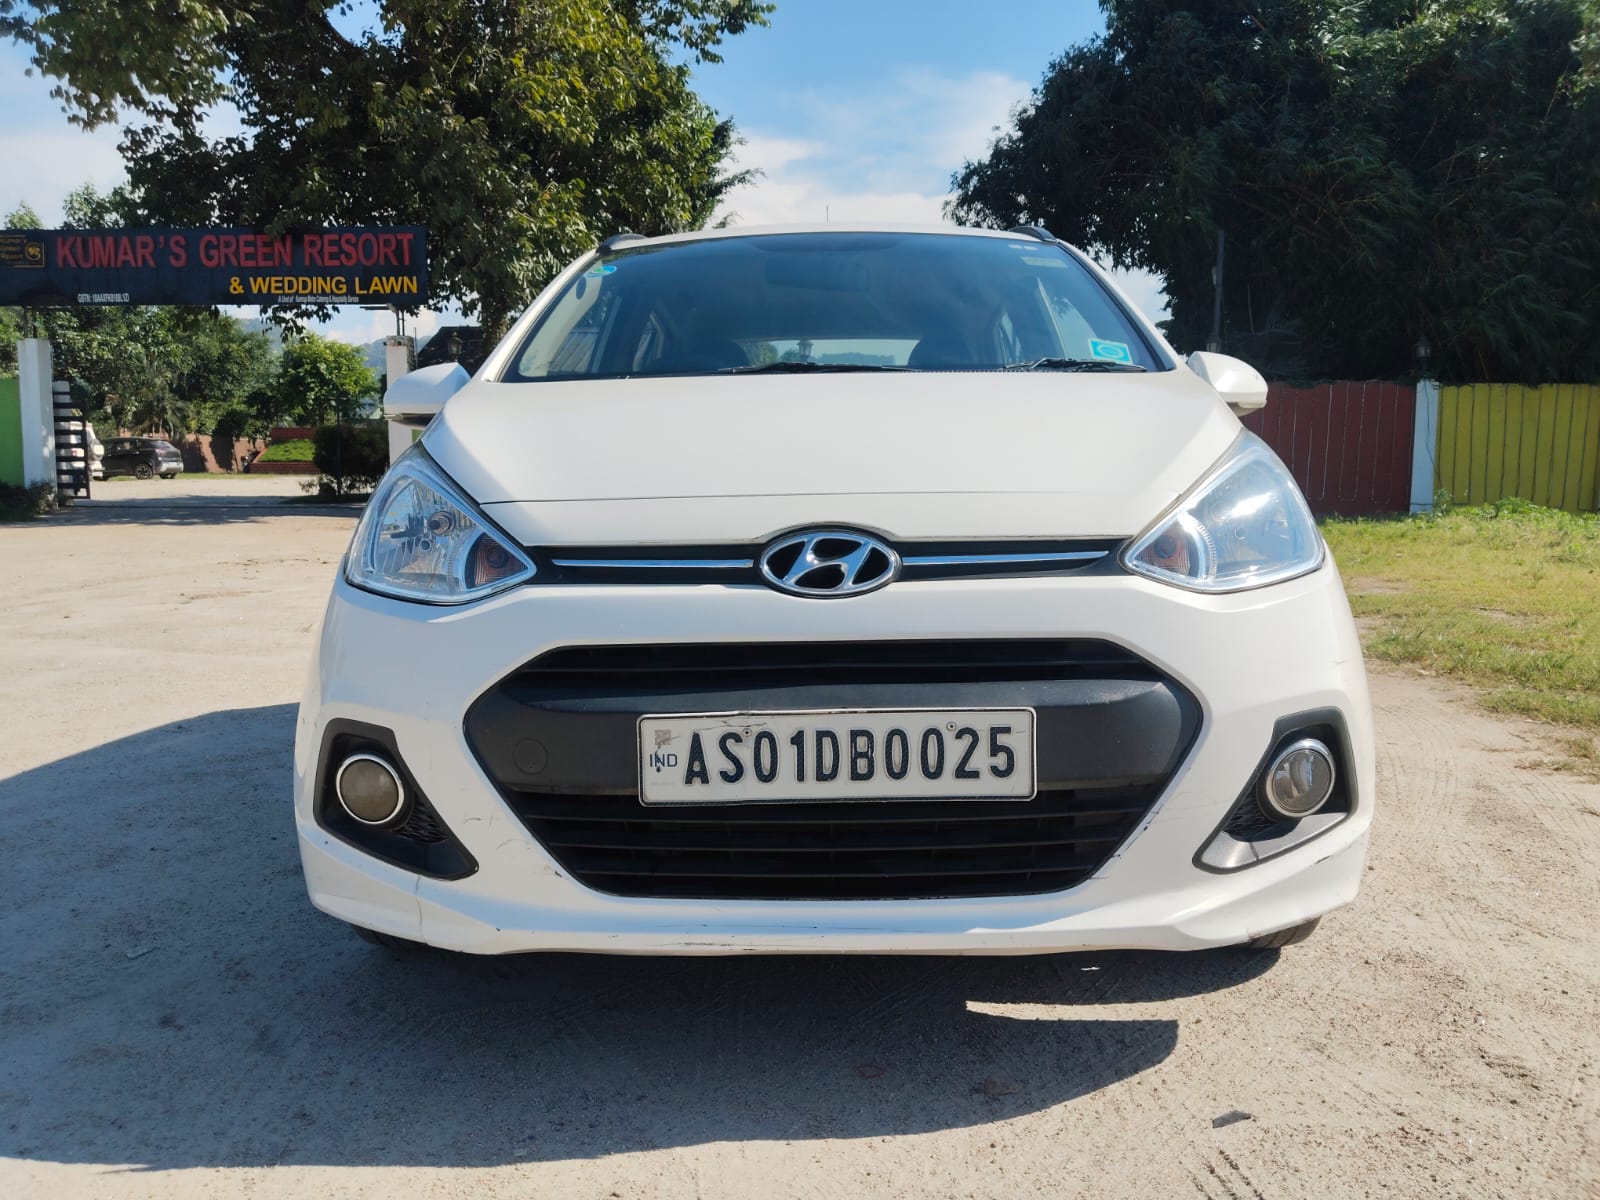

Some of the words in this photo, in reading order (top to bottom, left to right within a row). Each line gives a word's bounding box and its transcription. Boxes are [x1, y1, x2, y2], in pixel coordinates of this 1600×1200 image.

[56, 235, 187, 268] KUMAR'S
[199, 234, 292, 267] GREEN
[304, 233, 414, 266] RESORT
[229, 276, 244, 294] &
[249, 276, 347, 294] WEDDING
[355, 276, 418, 294] LAWN
[649, 753, 678, 768] IND
[683, 726, 1015, 785] AS01DB0025
